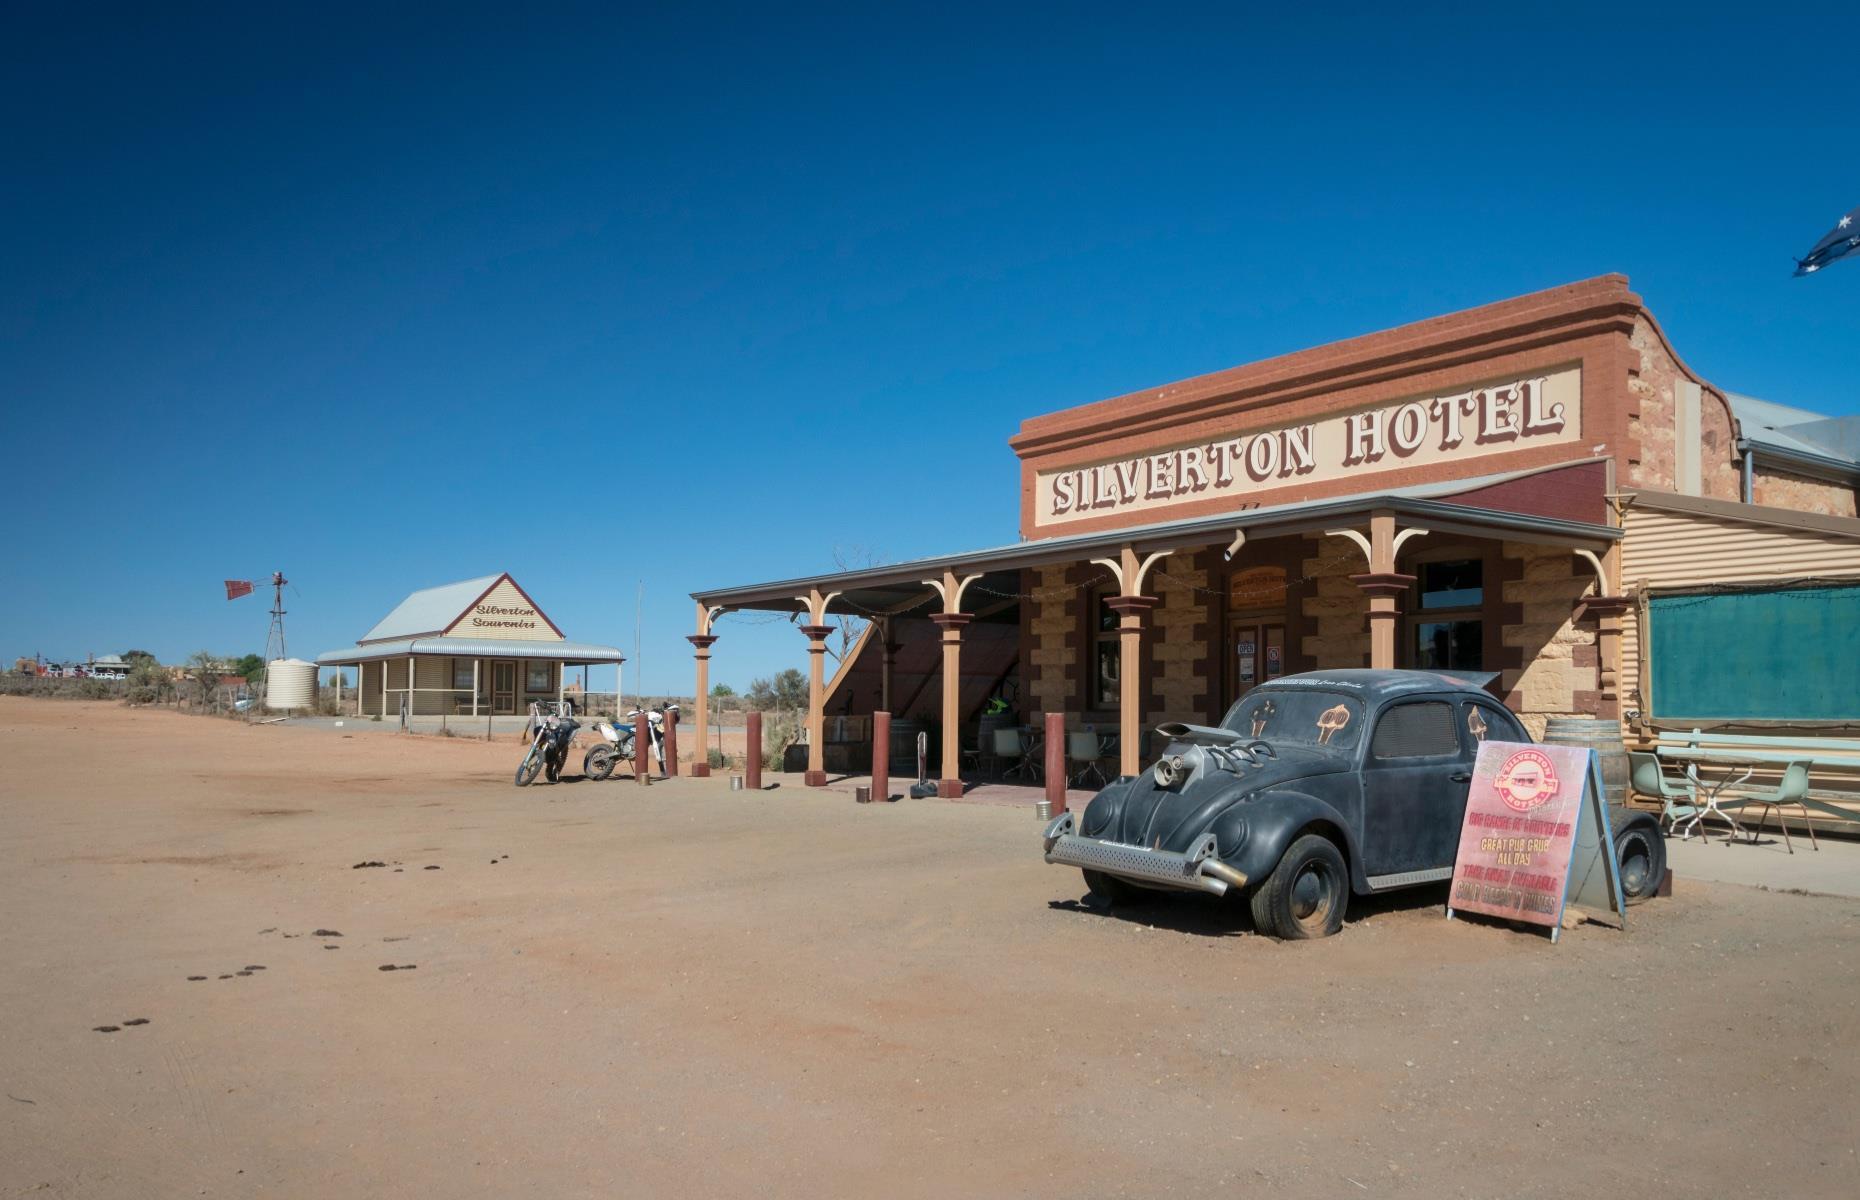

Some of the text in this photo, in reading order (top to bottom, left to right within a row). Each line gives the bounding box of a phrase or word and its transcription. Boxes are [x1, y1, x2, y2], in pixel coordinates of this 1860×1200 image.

[1051, 376, 1565, 515] SILVERTON HOTEL
[476, 605, 535, 616] Silverton
[472, 618, 536, 629] Souvenirs
[1239, 645, 1254, 653] OPEN
[1507, 795, 1541, 808] HOTEL
[1481, 837, 1550, 852] GREAT PUB GRUB
[1497, 852, 1531, 866] ALL DAY
